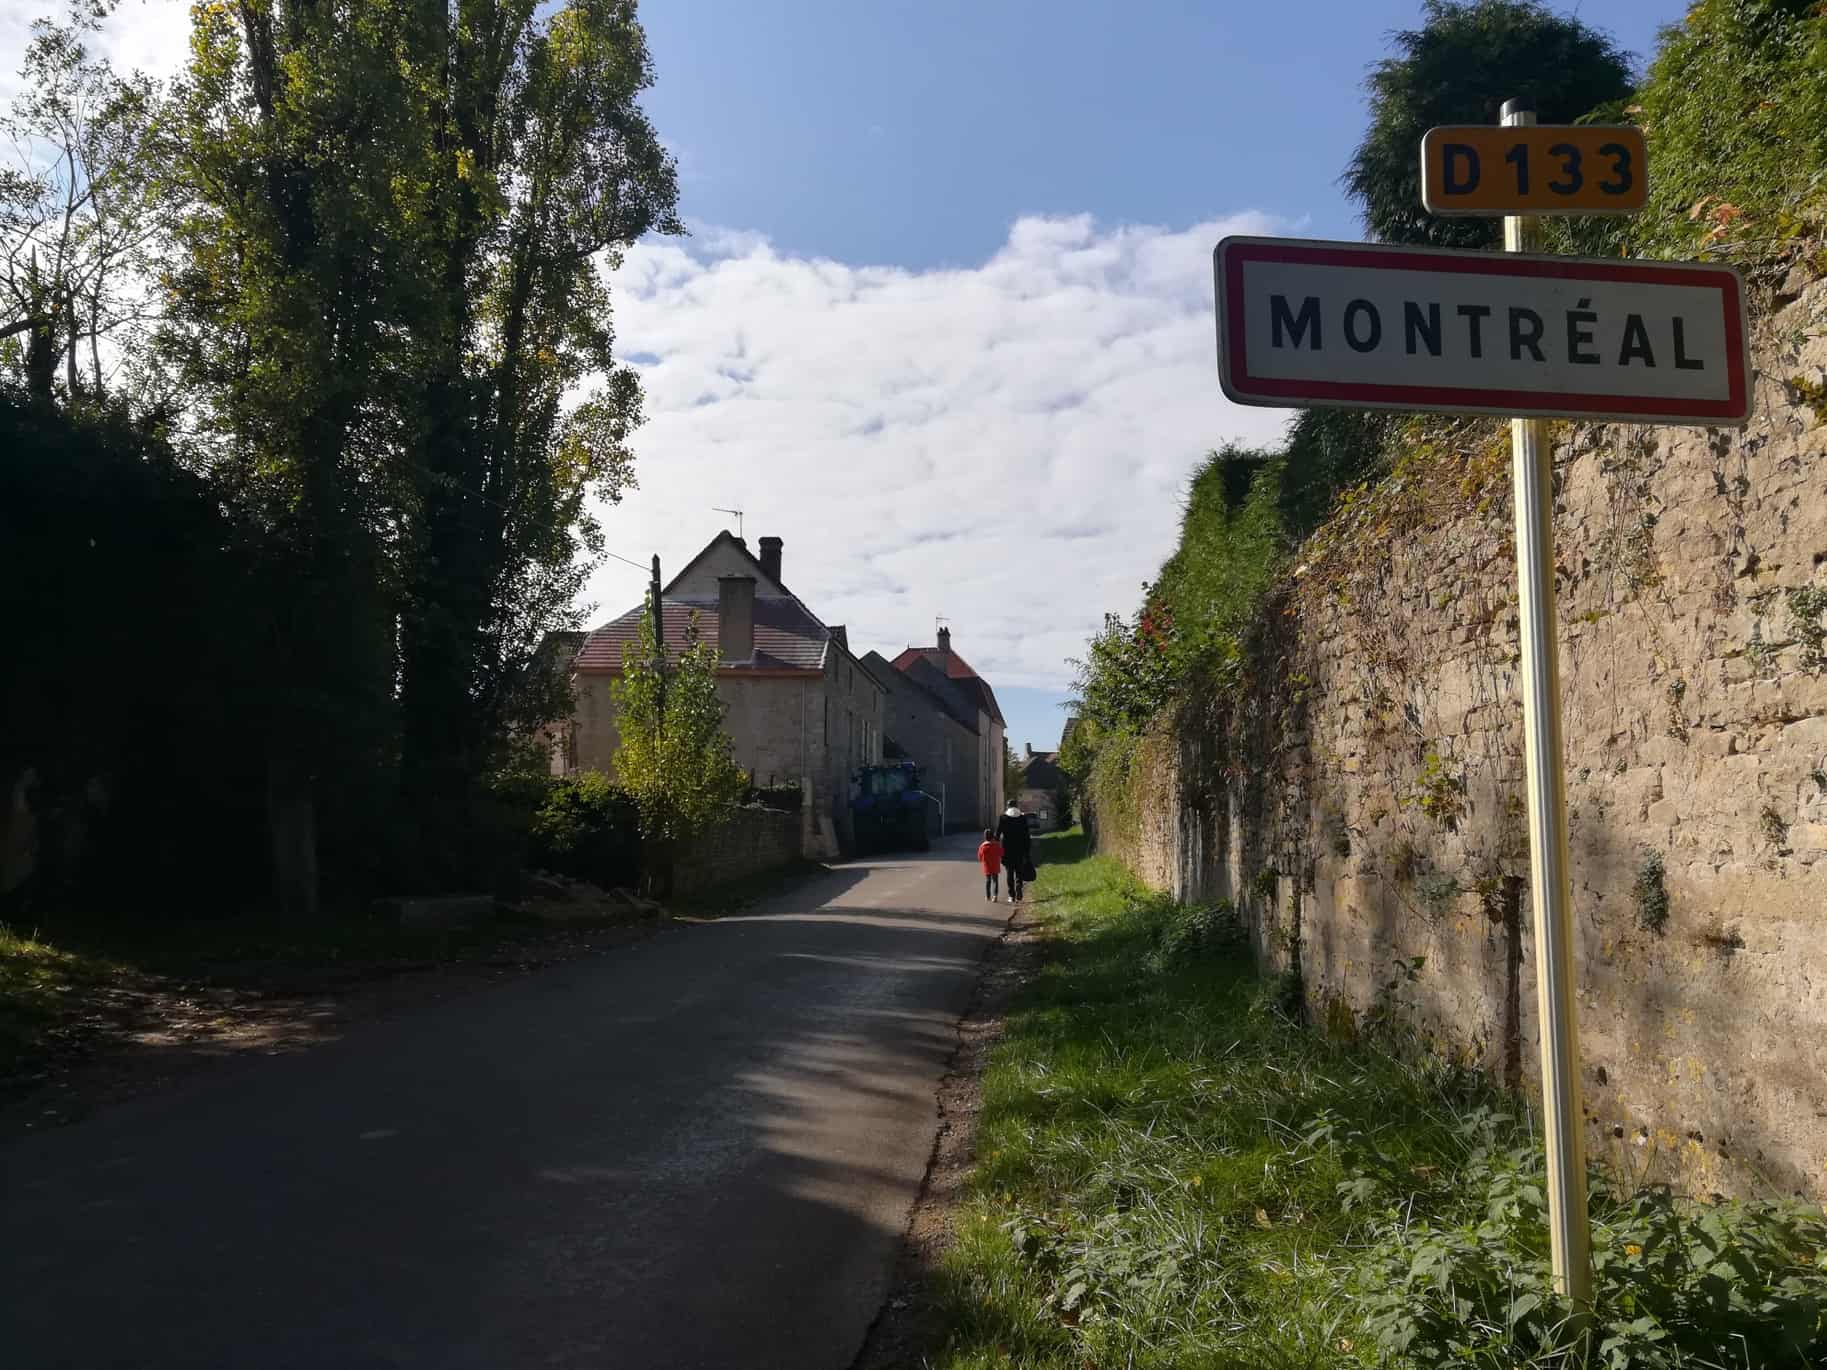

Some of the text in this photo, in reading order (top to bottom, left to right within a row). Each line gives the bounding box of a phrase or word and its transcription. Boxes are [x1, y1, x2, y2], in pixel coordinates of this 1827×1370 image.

[1443, 143, 1633, 194] D 133
[1270, 294, 1704, 370] MONTRÉAL
